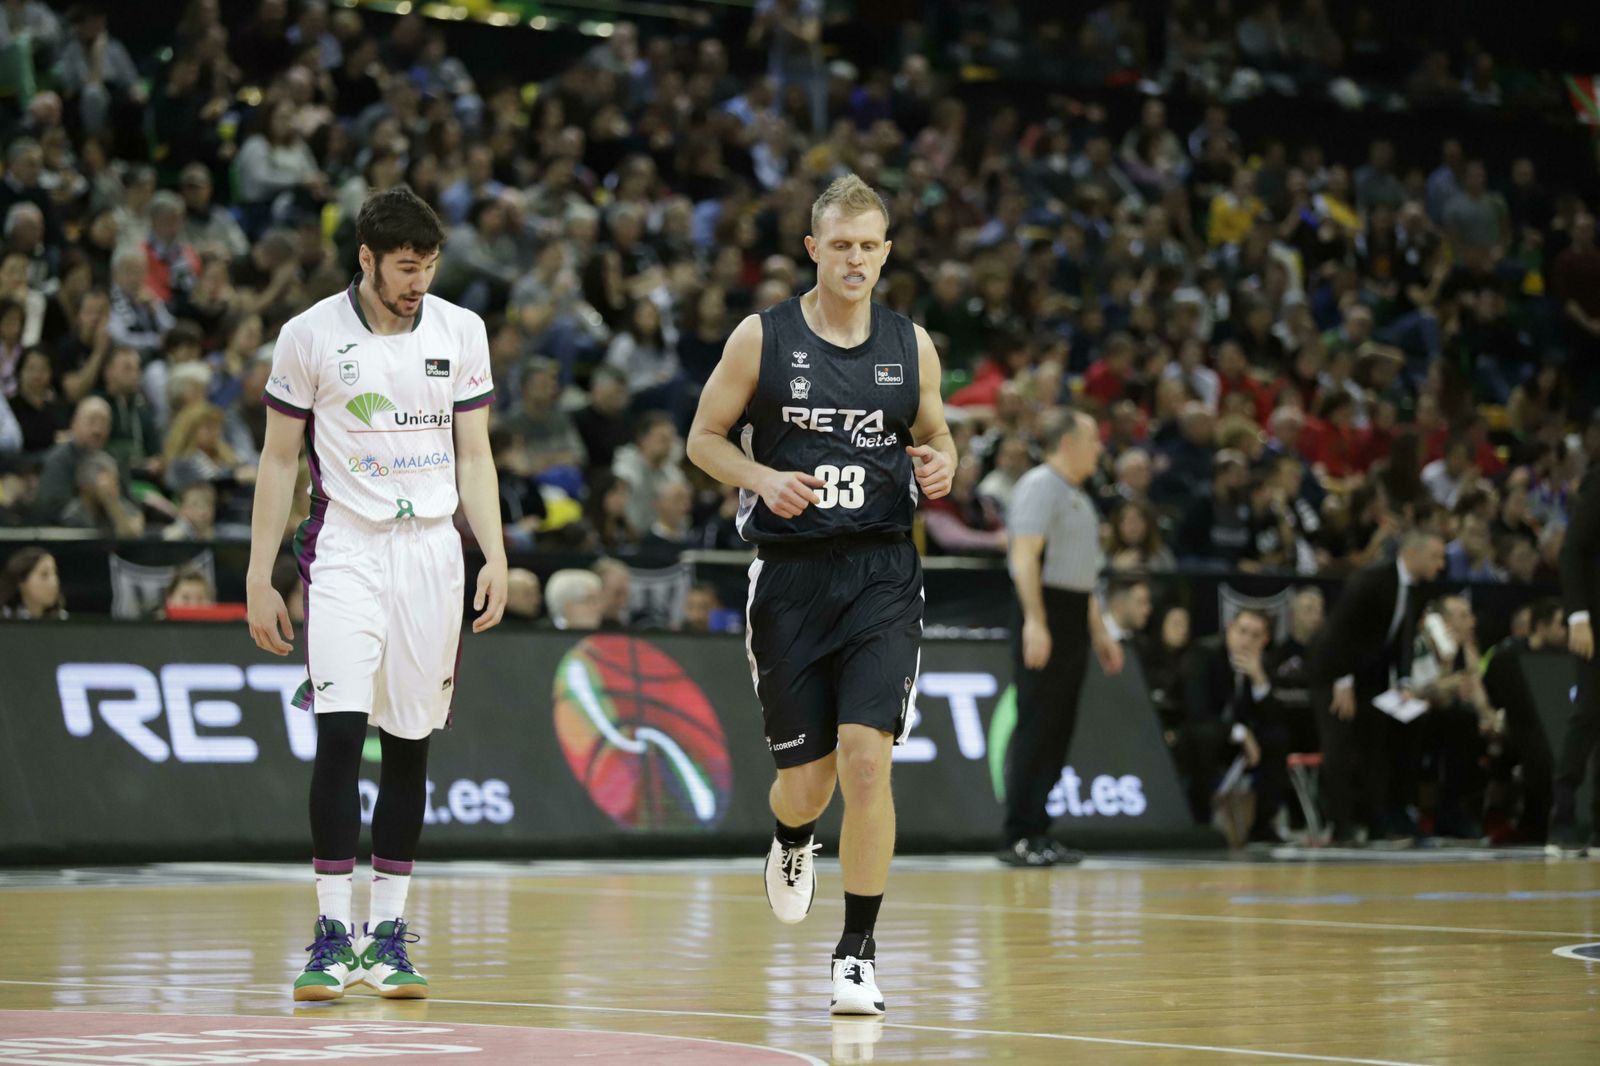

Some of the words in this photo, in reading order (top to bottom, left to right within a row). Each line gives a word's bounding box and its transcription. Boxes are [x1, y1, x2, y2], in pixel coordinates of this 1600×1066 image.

[394, 409, 451, 427] Unicaja
[781, 406, 884, 443] RETA
[813, 464, 866, 510] 33
[57, 662, 318, 764] RET
[1044, 765, 1147, 816] et.es
